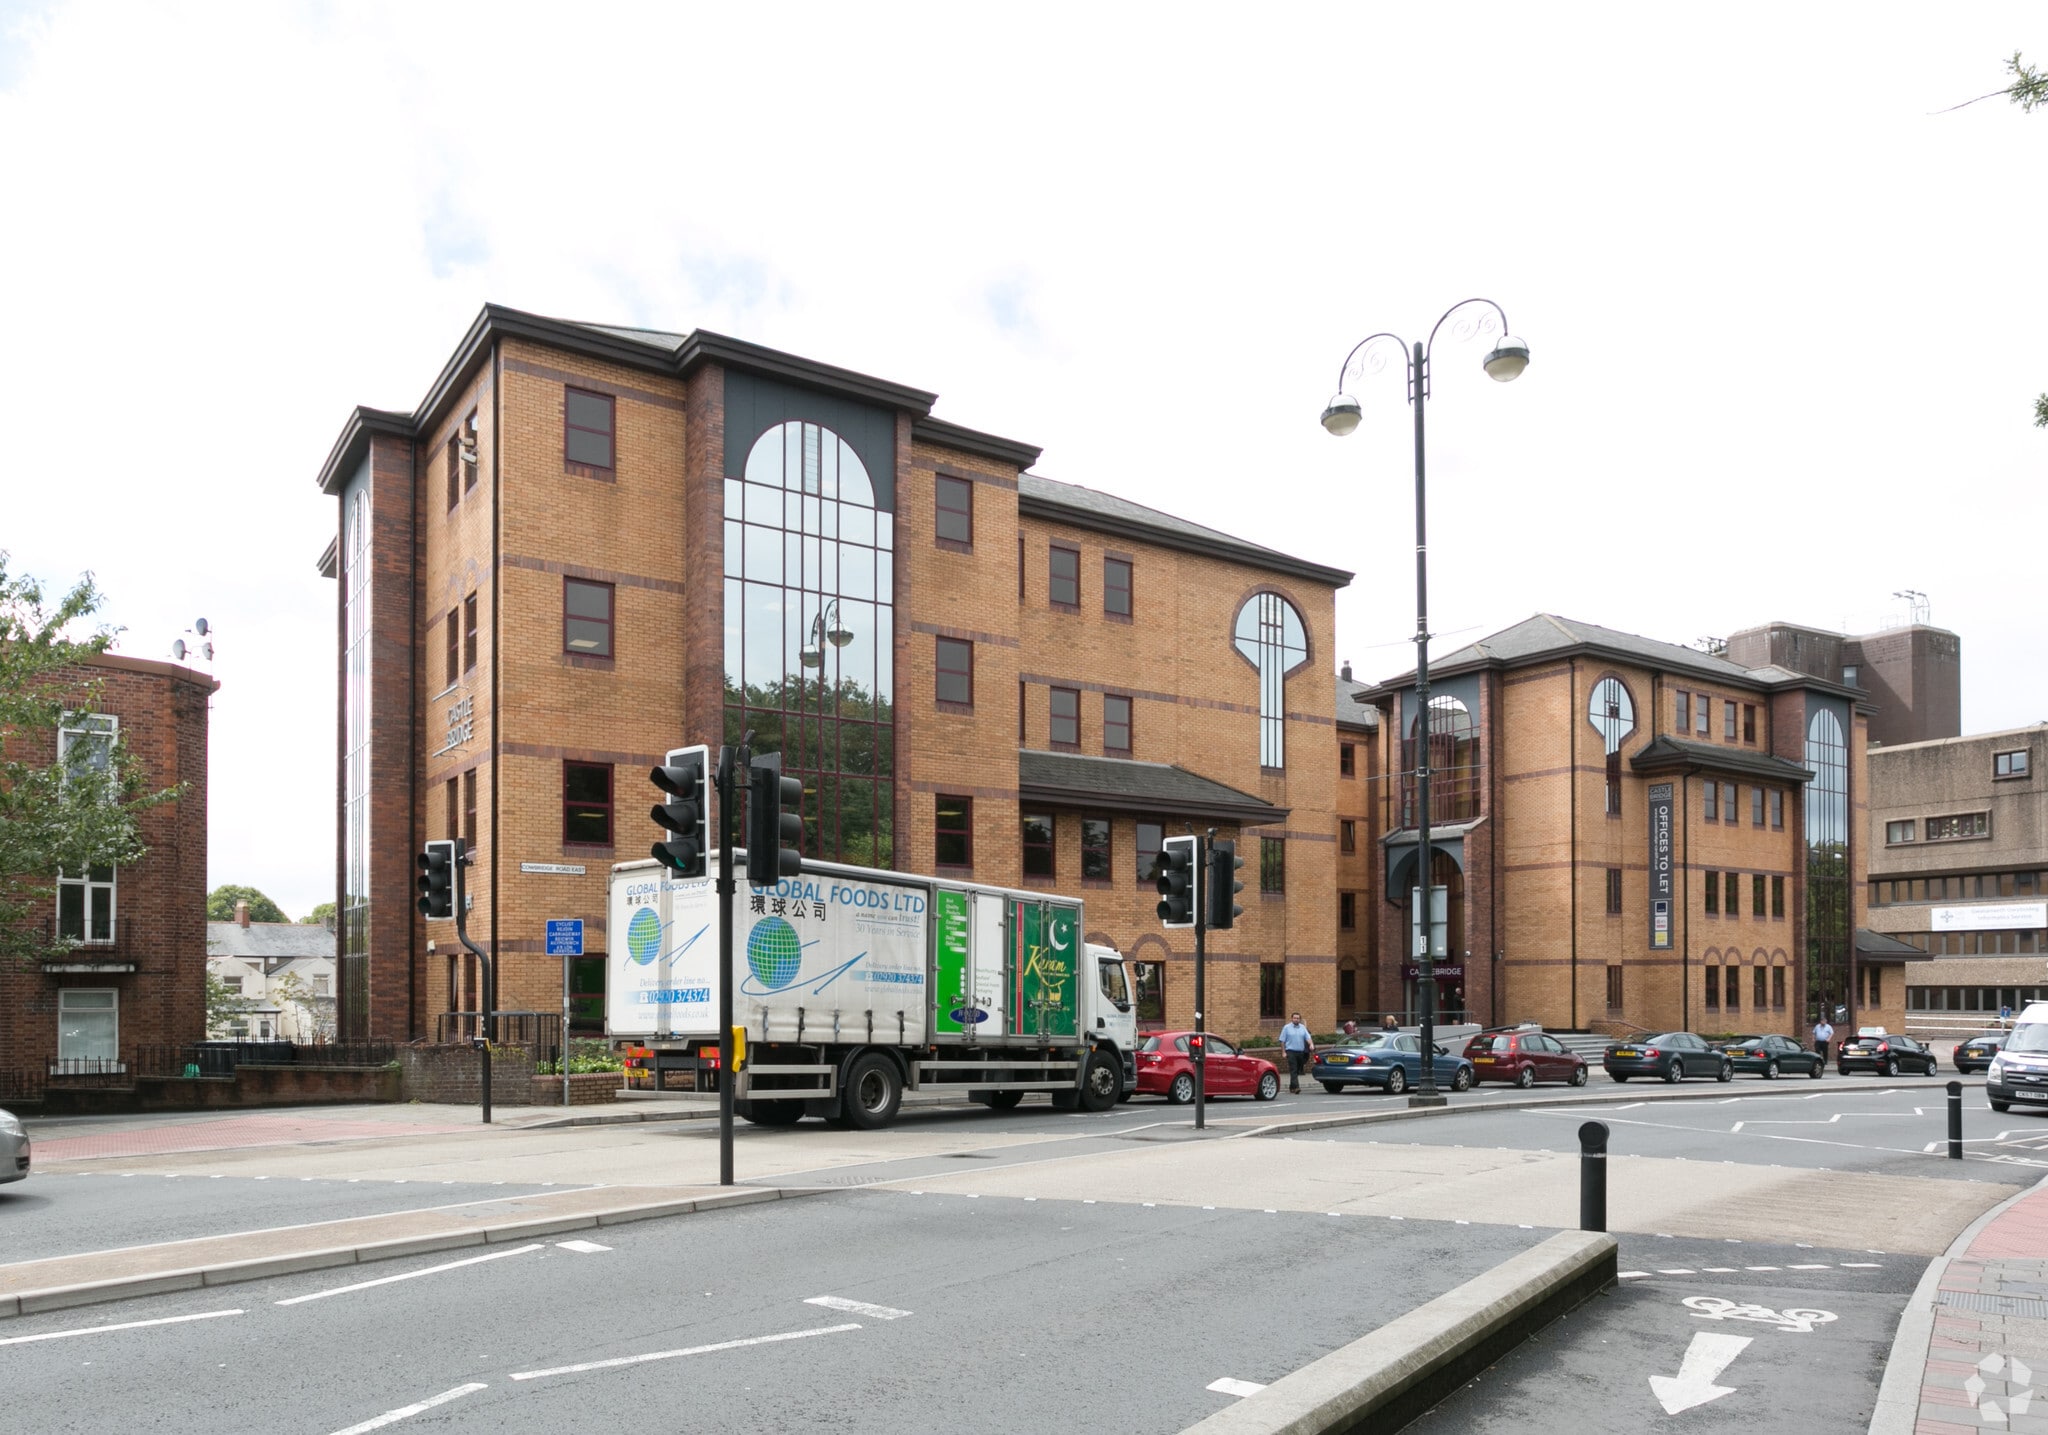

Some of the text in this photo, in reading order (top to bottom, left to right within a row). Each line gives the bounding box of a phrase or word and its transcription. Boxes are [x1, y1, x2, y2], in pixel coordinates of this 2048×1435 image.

[447, 694, 474, 726] CASTLE
[1659, 805, 1669, 894] OFFICES TO LET
[626, 883, 658, 896] GLOBAL
[830, 885, 889, 910] FOODS
[894, 893, 925, 914] LTD
[750, 895, 826, 921] 環球公司
[897, 973, 923, 984] 374374
[1409, 967, 1462, 976] CAEBRIDGE
[649, 988, 709, 1003] 02920 374374
